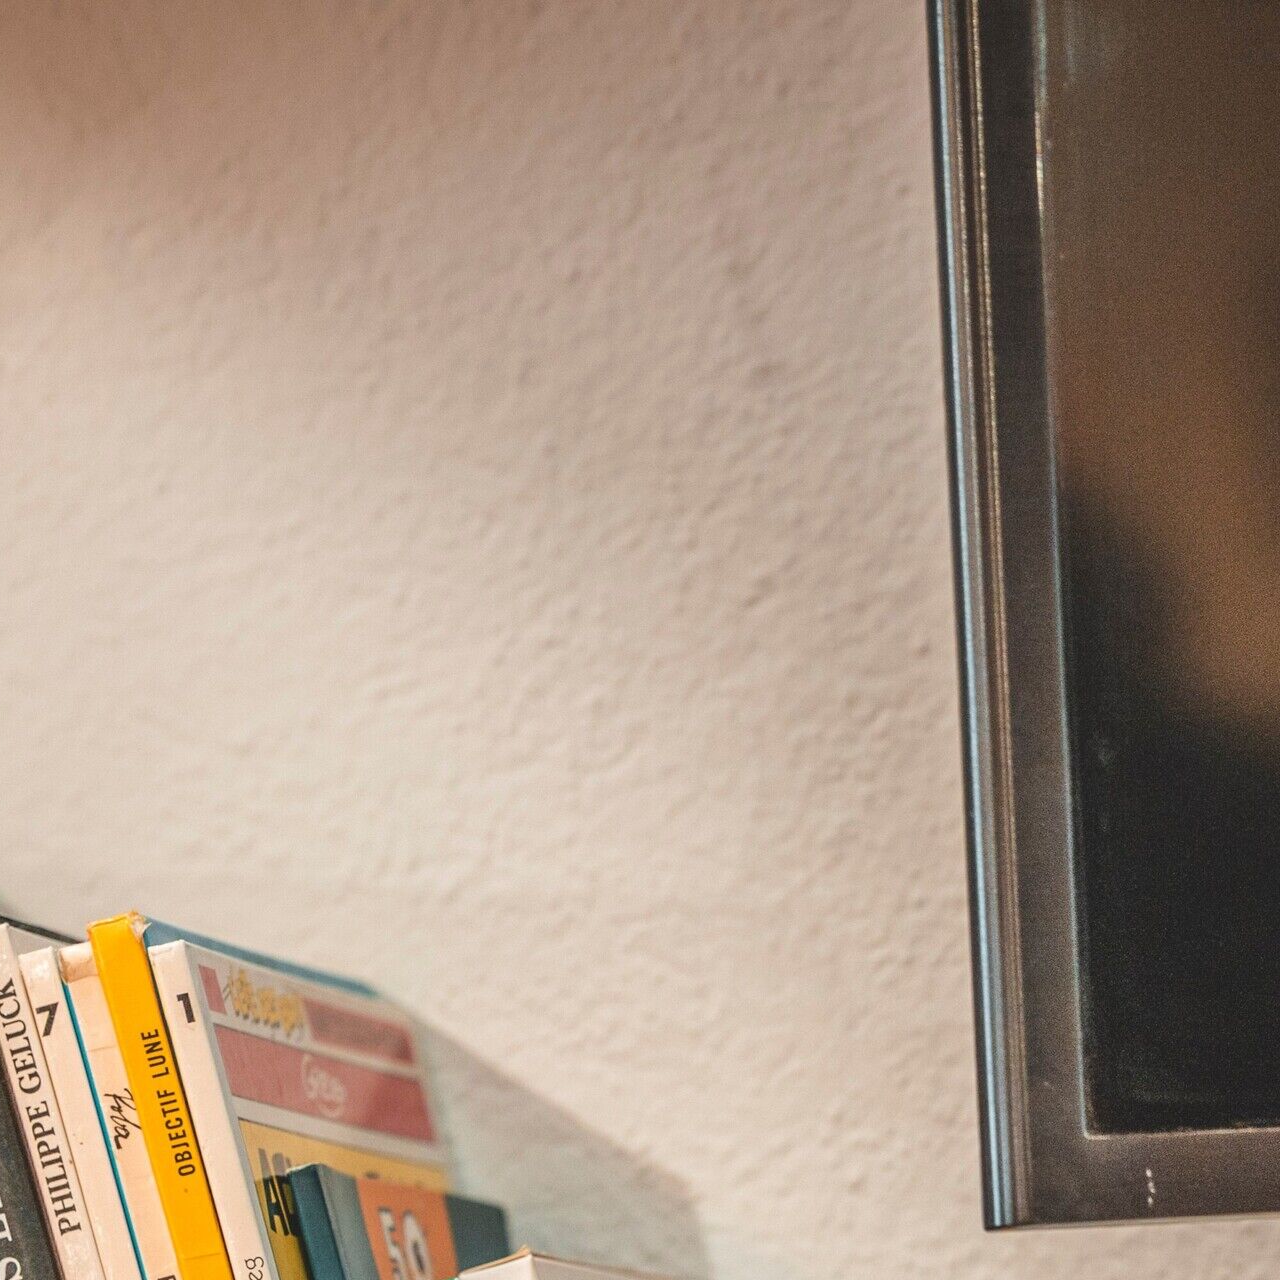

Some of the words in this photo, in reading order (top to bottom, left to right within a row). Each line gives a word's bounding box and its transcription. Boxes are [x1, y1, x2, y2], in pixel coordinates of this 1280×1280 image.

[36, 1002, 59, 1037] 7
[177, 992, 196, 1024] 1
[140, 1028, 170, 1079] LUNE
[156, 1089, 196, 1177] OBJECTIF
[25, 1100, 82, 1237] PHILIPPE
